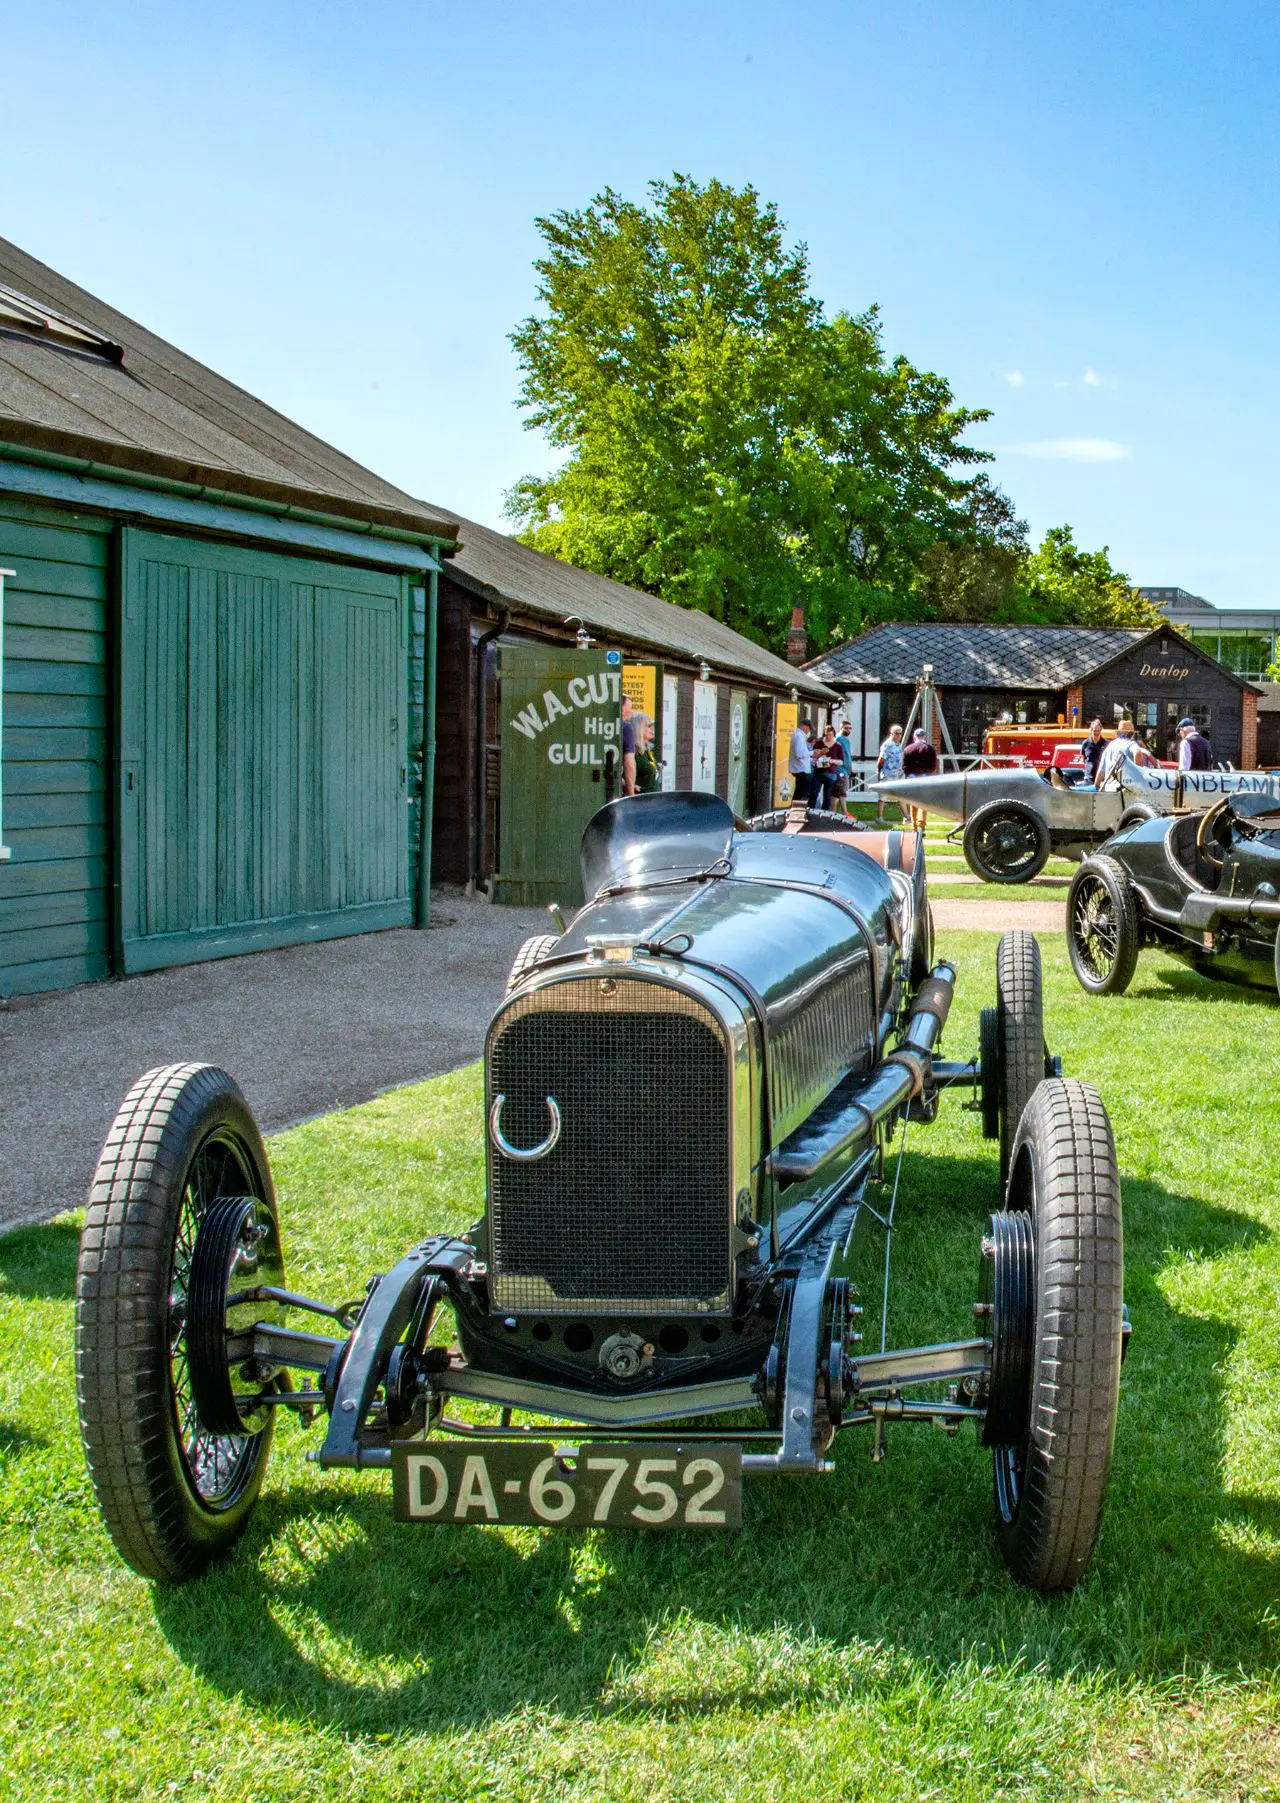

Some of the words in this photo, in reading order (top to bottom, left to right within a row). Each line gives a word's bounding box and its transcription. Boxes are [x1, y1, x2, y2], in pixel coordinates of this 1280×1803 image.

[1139, 663, 1190, 681] Dunlop
[1148, 772, 1269, 794] SUNBEAM
[406, 1455, 727, 1524] DA-6752
